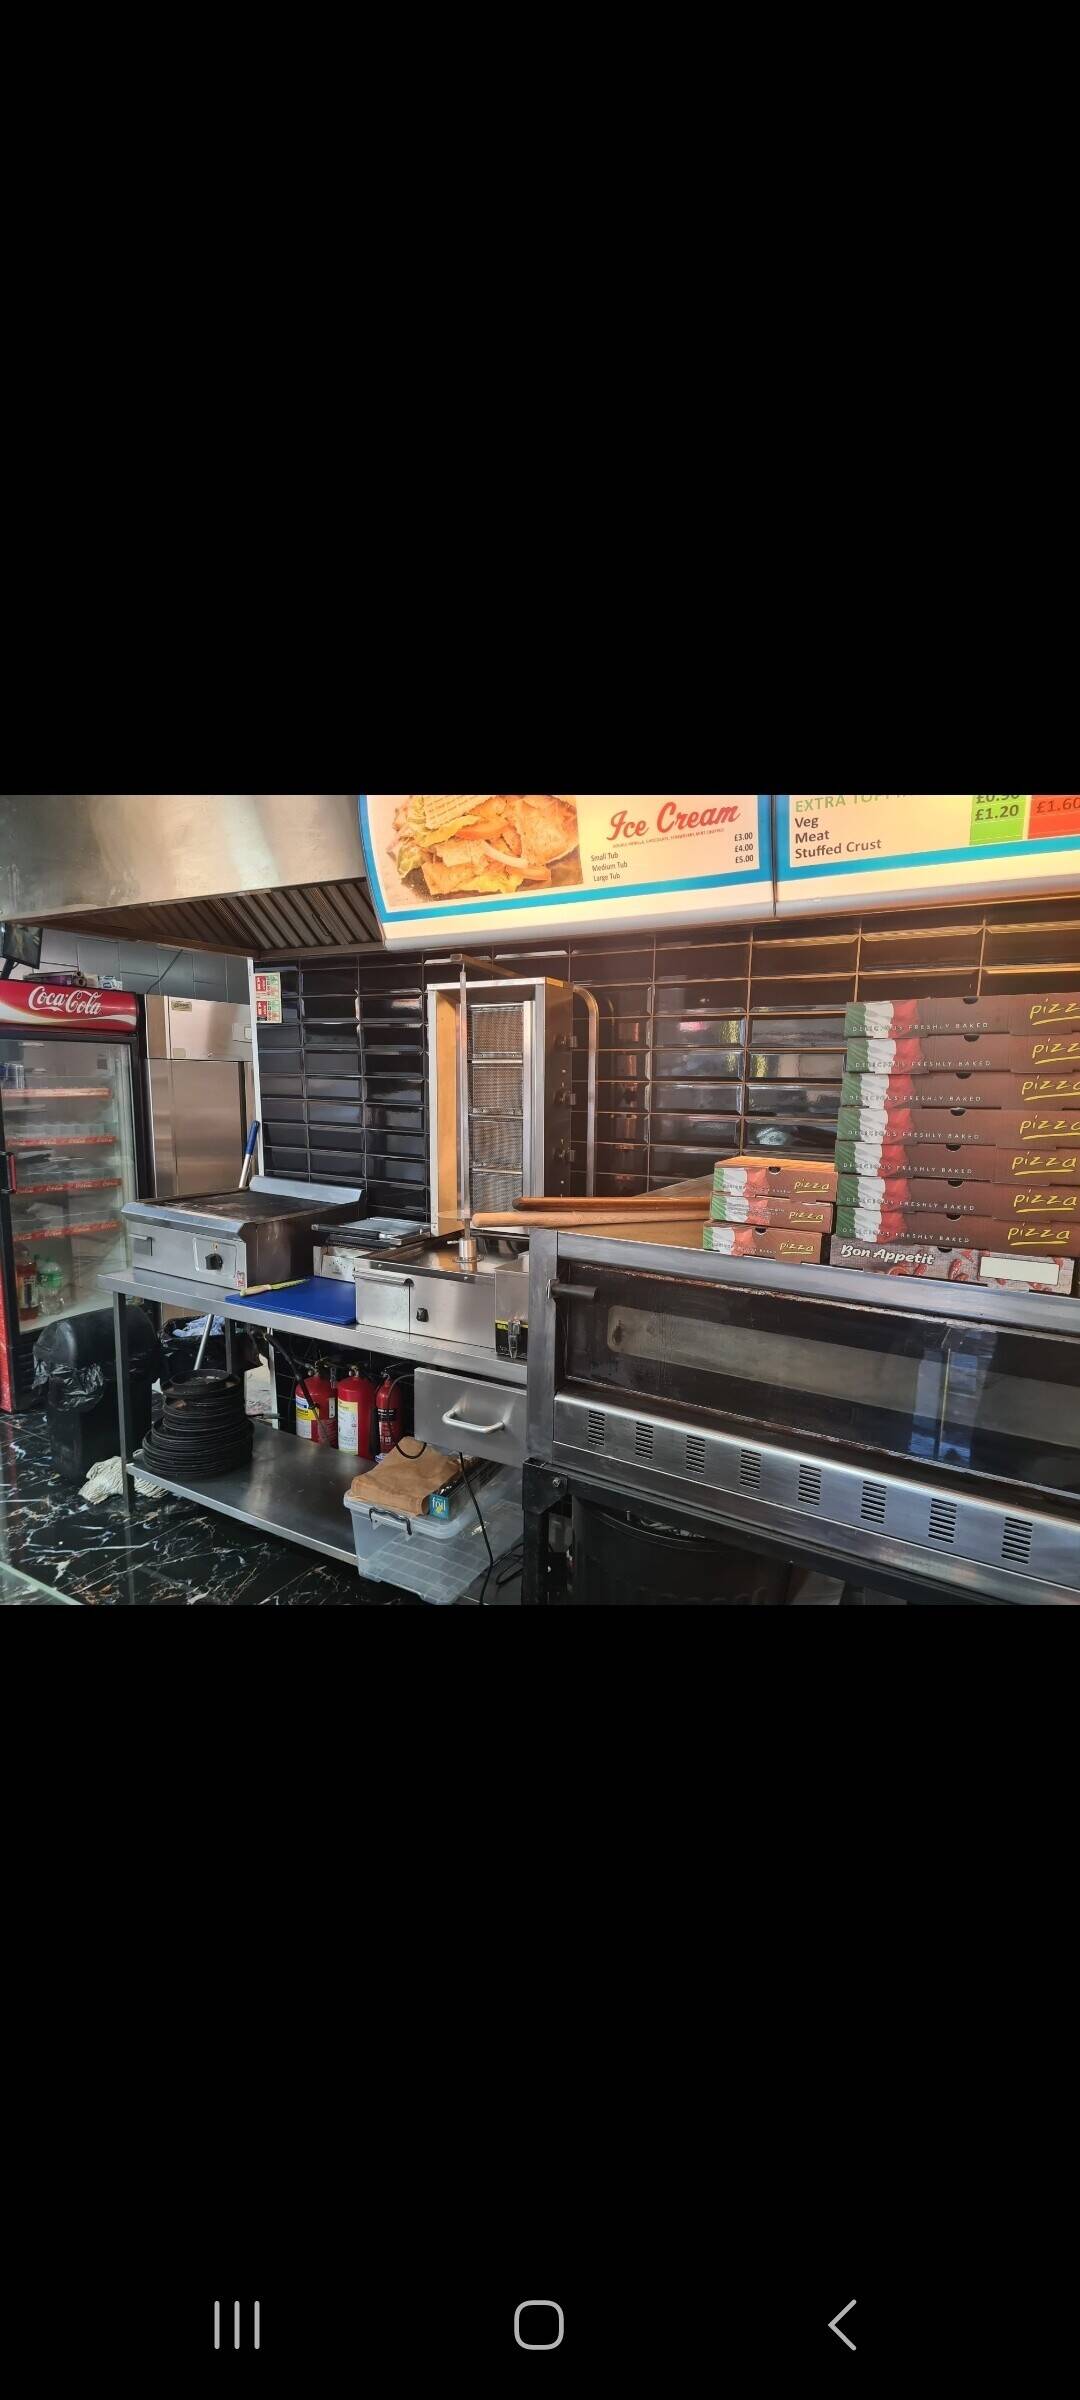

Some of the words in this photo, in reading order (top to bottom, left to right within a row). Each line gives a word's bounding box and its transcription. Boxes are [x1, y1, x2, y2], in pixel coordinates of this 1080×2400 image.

[795, 795, 846, 812] EXTRA
[975, 804, 1019, 821] £1.20
[606, 810, 649, 841] Ice
[656, 801, 741, 833] Cream
[794, 816, 819, 829] Veg
[734, 832, 753, 842] £3.00
[794, 829, 830, 844] Meat
[734, 843, 754, 853] £4.00
[794, 843, 842, 859] Stuffed
[846, 838, 882, 853] Crust
[590, 853, 607, 862] Small
[607, 852, 619, 860] Tub
[735, 854, 754, 864] £5.00
[592, 863, 616, 872] Medium
[617, 861, 628, 869] Tub
[593, 874, 609, 883] Large
[609, 872, 621, 880] Tub
[1030, 998, 1080, 1020] pizz
[1032, 1037, 1080, 1059] pizz
[1012, 1151, 1076, 1170] pizza
[794, 1179, 830, 1190] pizza
[1013, 1188, 1077, 1207] pizza
[789, 1210, 824, 1220] pizza
[1007, 1222, 1070, 1240] pizza
[779, 1240, 814, 1251] pizza
[840, 1244, 870, 1258] Bon
[873, 1248, 936, 1265] Appetit
